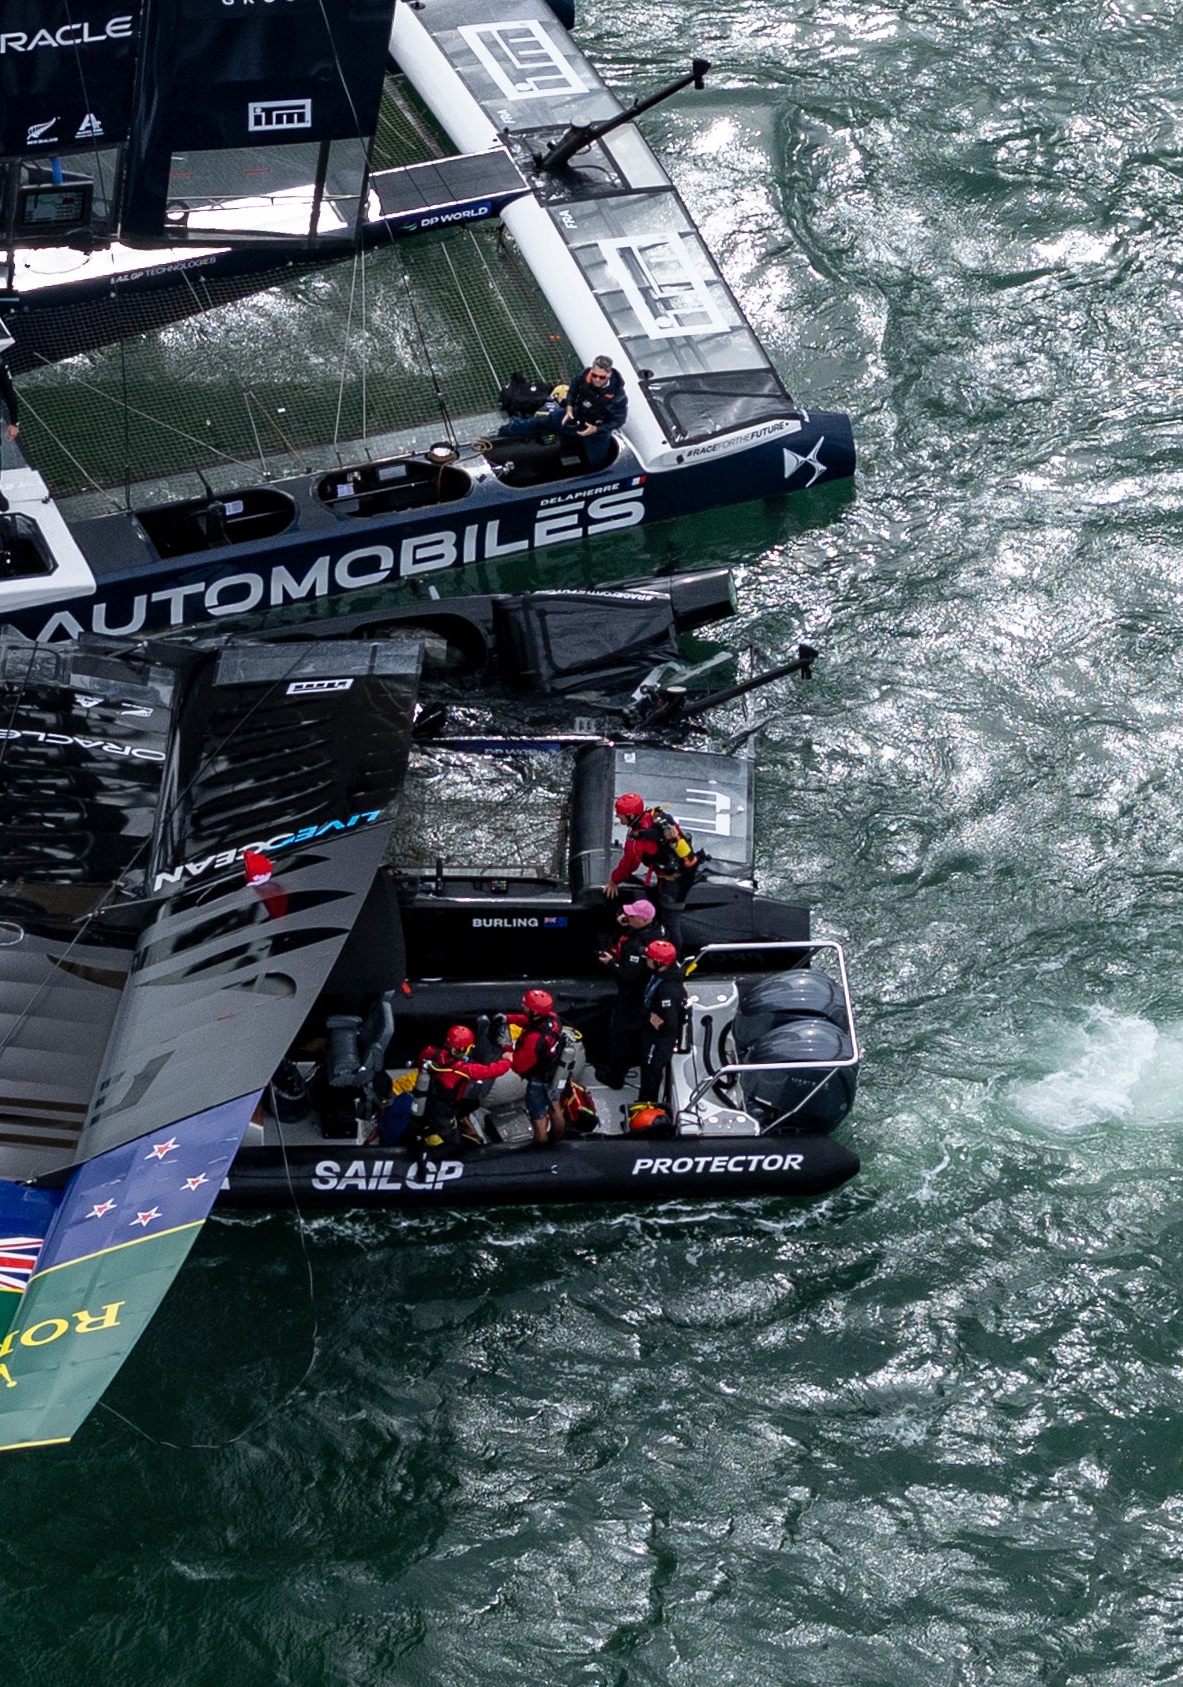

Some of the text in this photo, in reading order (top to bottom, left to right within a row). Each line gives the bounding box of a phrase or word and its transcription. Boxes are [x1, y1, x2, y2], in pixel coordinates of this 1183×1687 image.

[420, 206, 488, 227] DP WORLD
[540, 482, 620, 507] DELAPIERRE
[34, 486, 645, 643] AUTOMOBILES
[472, 918, 539, 928] BURLING
[632, 1154, 804, 1175] PROTECTOR
